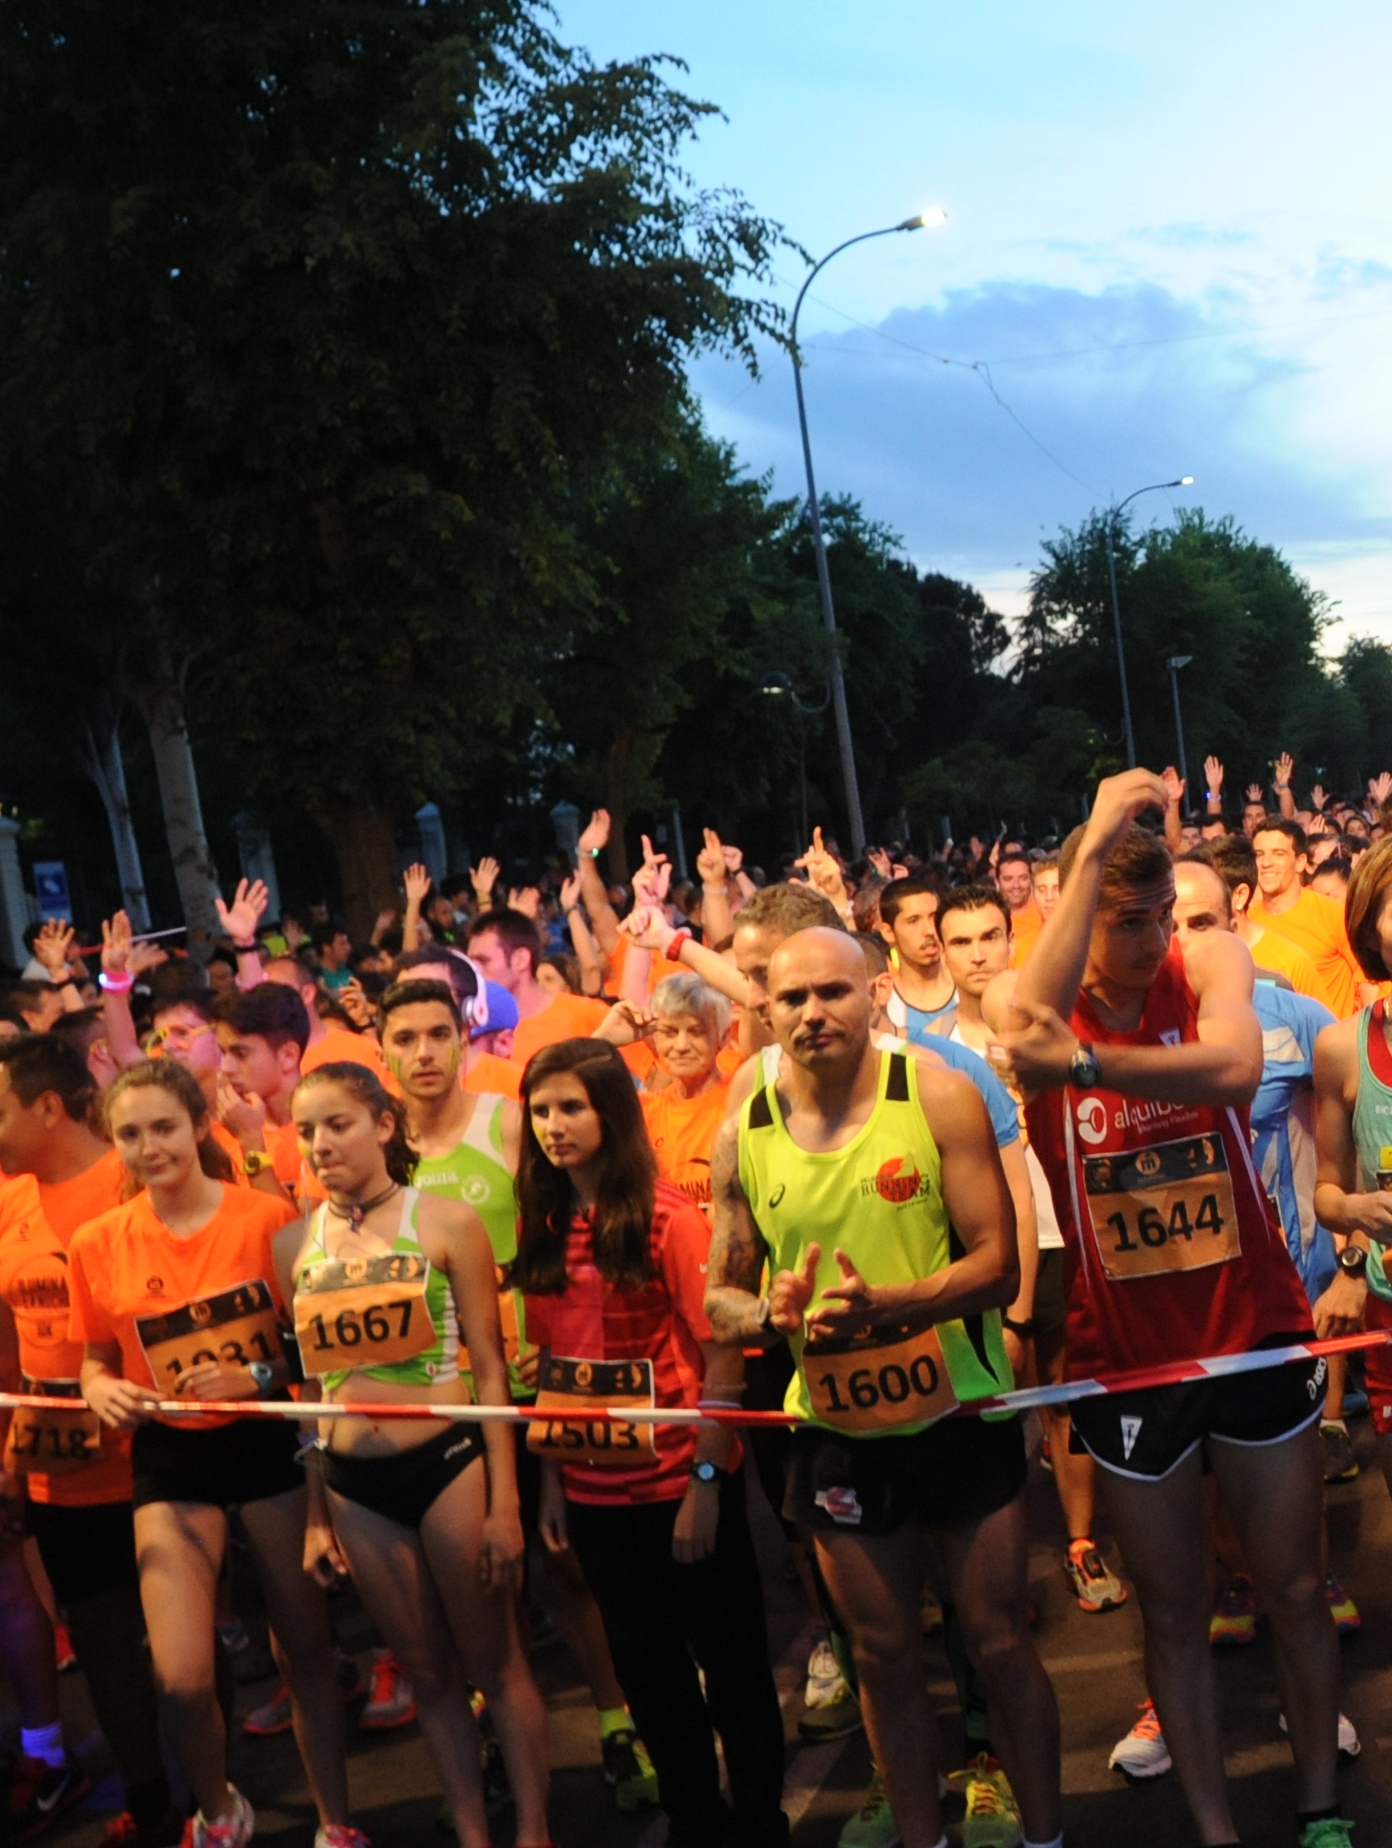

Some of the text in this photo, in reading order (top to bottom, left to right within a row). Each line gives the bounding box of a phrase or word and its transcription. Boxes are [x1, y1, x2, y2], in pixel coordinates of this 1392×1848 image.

[1107, 1194, 1225, 1252] 1644
[309, 1300, 413, 1351] 1667
[819, 1355, 939, 1412] 1600
